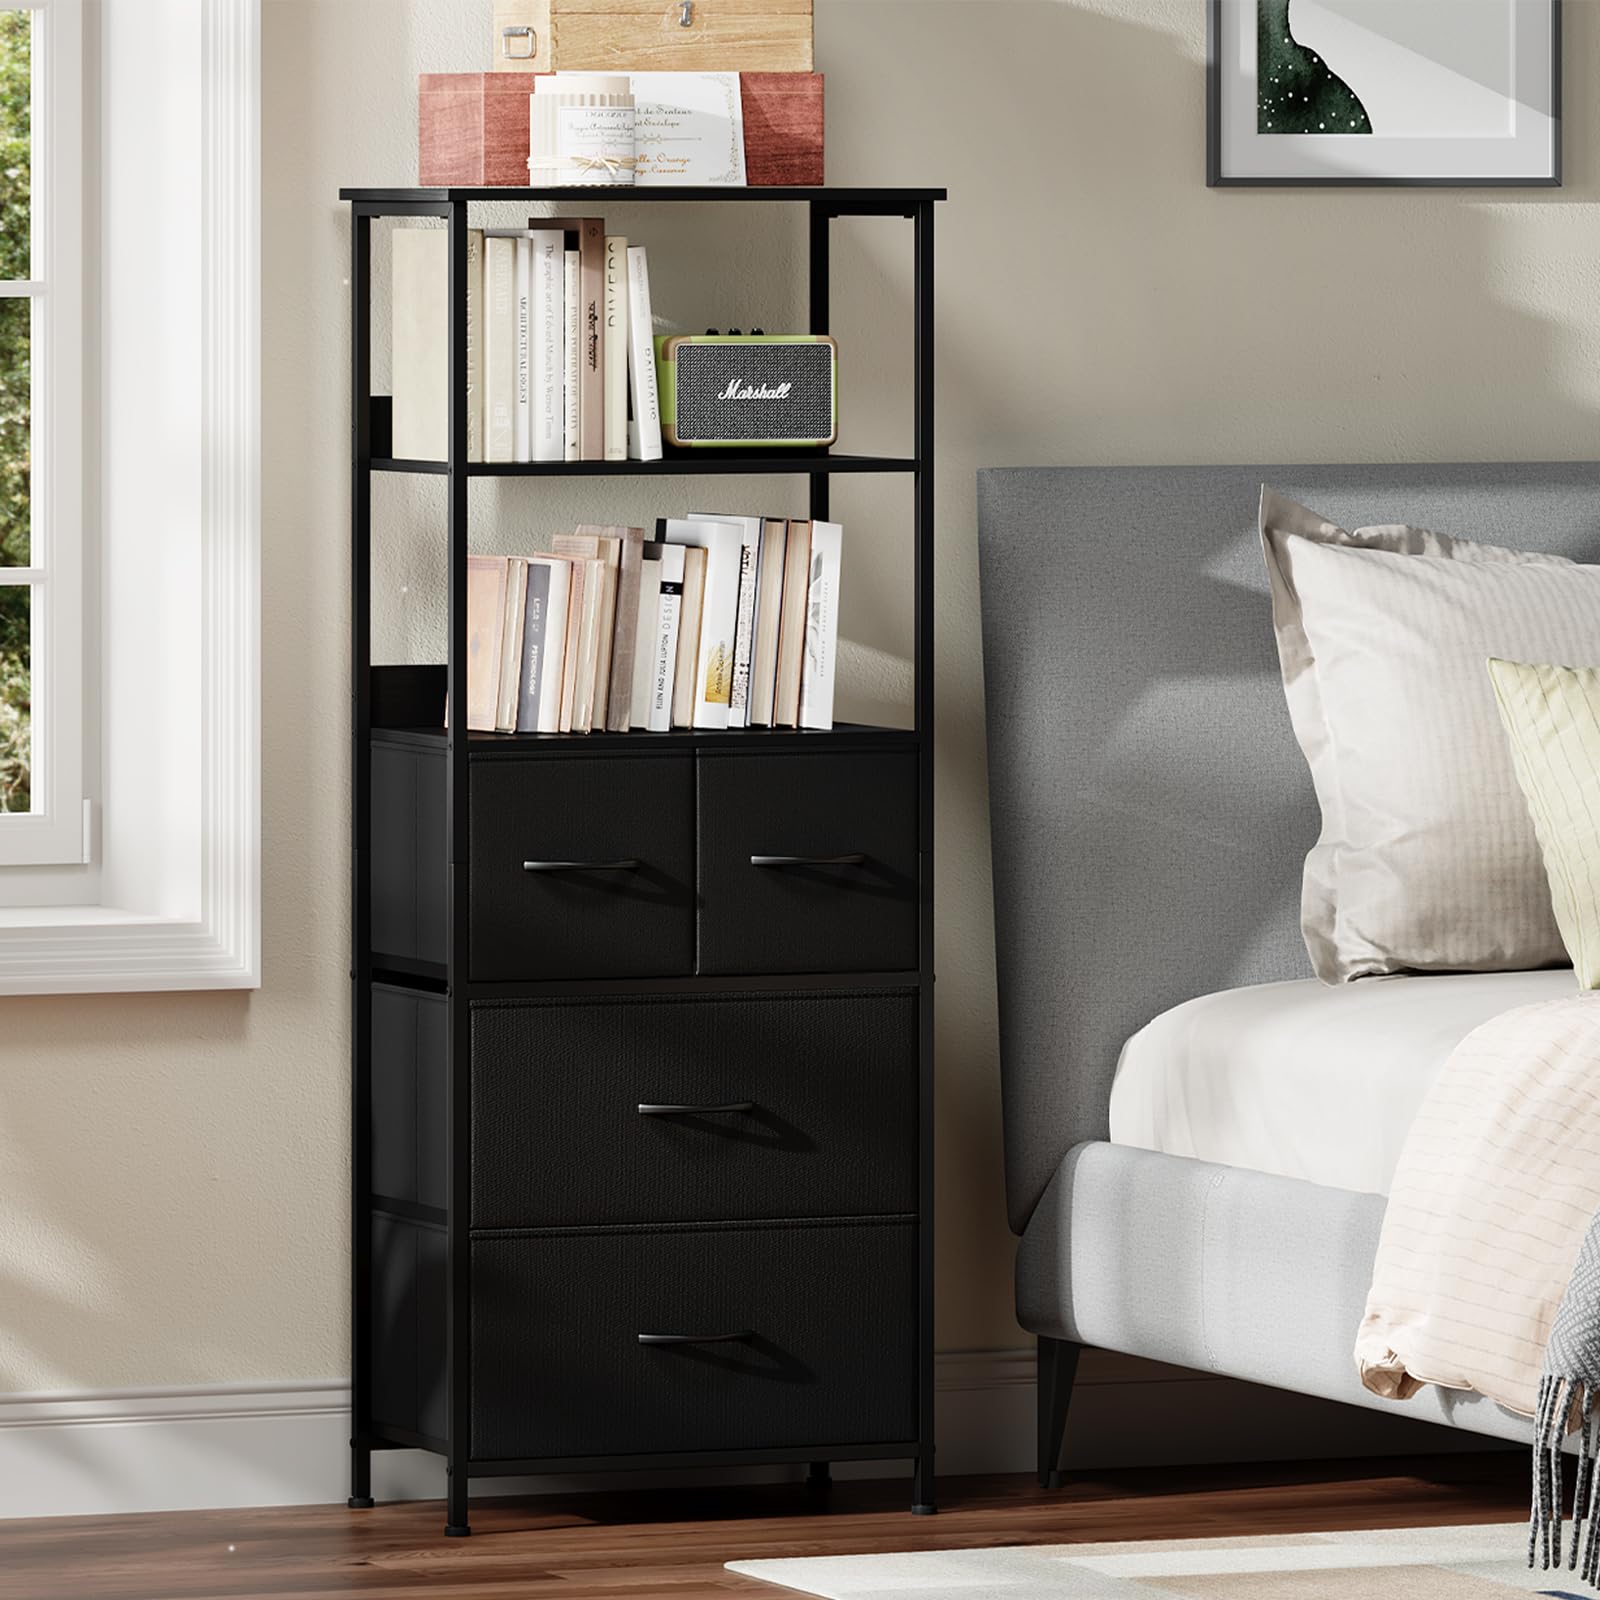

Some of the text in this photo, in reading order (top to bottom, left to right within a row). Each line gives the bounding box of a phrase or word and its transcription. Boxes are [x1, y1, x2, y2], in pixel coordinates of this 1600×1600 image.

[545, 244, 555, 259] The
[544, 261, 554, 290] graphic
[545, 291, 553, 303] art
[545, 304, 554, 314] of
[519, 296, 528, 404] ARCHITECTURAL DIGEST
[717, 379, 792, 400] Marshall
[661, 585, 674, 630] DESIGN
[528, 644, 540, 696] PSYCHOLOGY
[656, 634, 669, 710] ELLEN AND JULIA LUPTON
